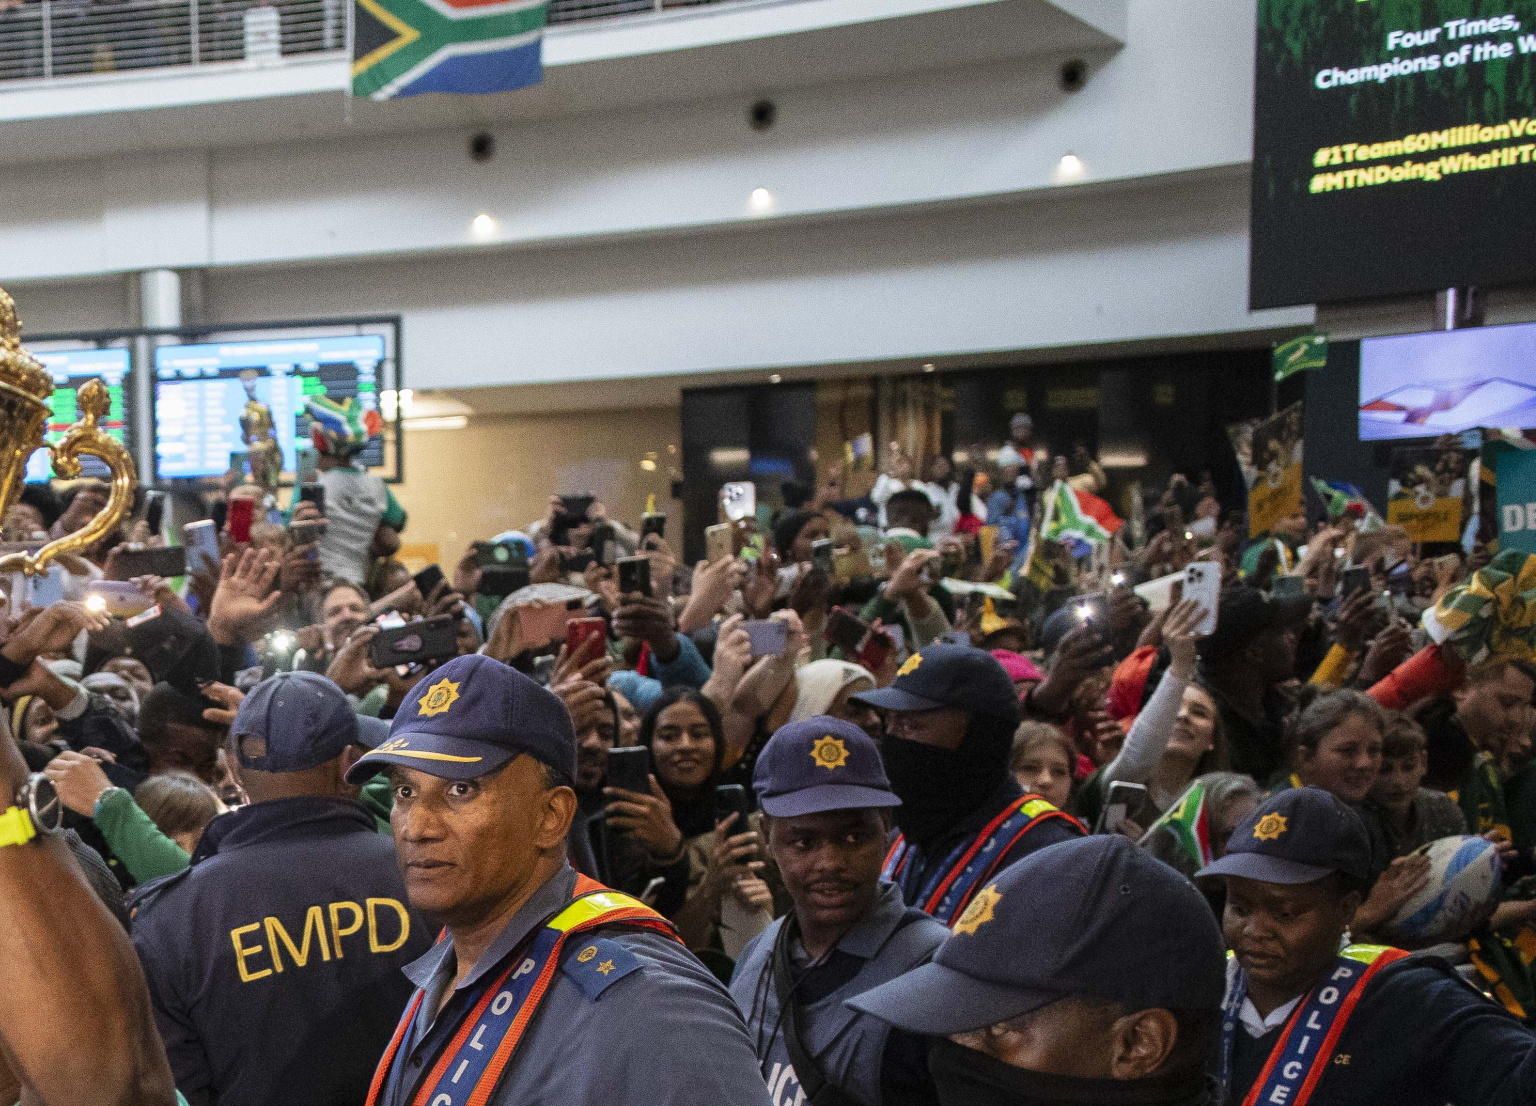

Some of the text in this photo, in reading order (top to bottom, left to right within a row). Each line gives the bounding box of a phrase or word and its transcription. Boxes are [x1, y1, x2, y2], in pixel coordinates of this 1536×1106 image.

[1386, 14, 1521, 51] Four Times,
[1314, 53, 1441, 90] Champions
[1442, 44, 1472, 68] of
[1472, 40, 1514, 64] the
[1313, 117, 1536, 168] #1Team60MillionVo
[230, 897, 411, 983] EMPD
[1268, 966, 1353, 1106] POLICE
